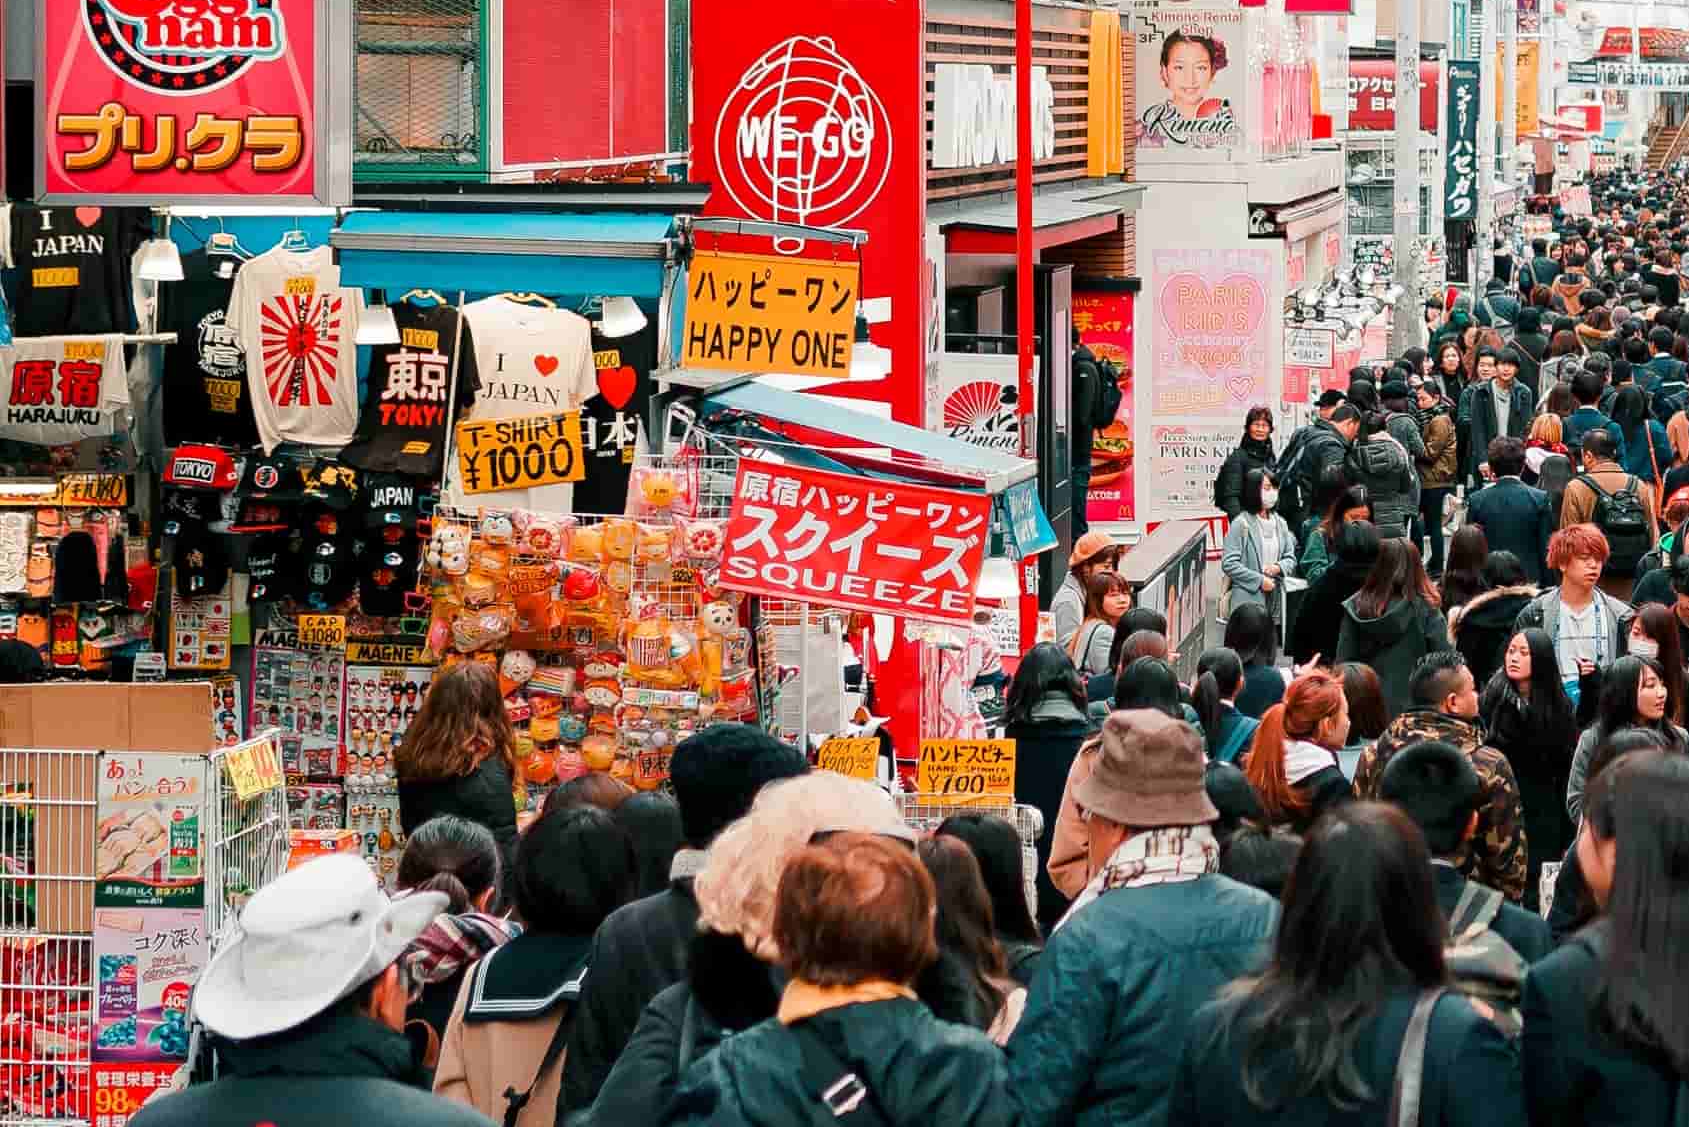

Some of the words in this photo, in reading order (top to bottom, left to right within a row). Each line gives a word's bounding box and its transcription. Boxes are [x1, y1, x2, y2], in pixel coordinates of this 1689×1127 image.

[143, 15, 273, 49] nam
[1151, 11, 1201, 23] Kimono
[1138, 33, 1156, 43] 3F
[1142, 104, 1235, 144] Kimono
[31, 233, 104, 258] JAPAN
[692, 267, 851, 315] ハッピーワン
[688, 321, 782, 364] HAPPY
[791, 329, 848, 369] ONE
[8, 359, 104, 408] 原宿
[381, 347, 449, 401] 東京
[481, 381, 560, 405] JAPAN
[7, 408, 100, 425] HARAJUKU
[379, 403, 444, 426] TOKY
[580, 411, 636, 450] 日本
[463, 417, 568, 447] T-SHIRT
[175, 459, 212, 480] TOKYO
[463, 438, 574, 490] ¥1000
[370, 486, 413, 508] JAPAN
[738, 473, 986, 533] 原宿ハッピーワン
[731, 505, 979, 589] スクイーズ
[726, 556, 973, 614] SQUEEZE
[305, 616, 338, 627] CAP
